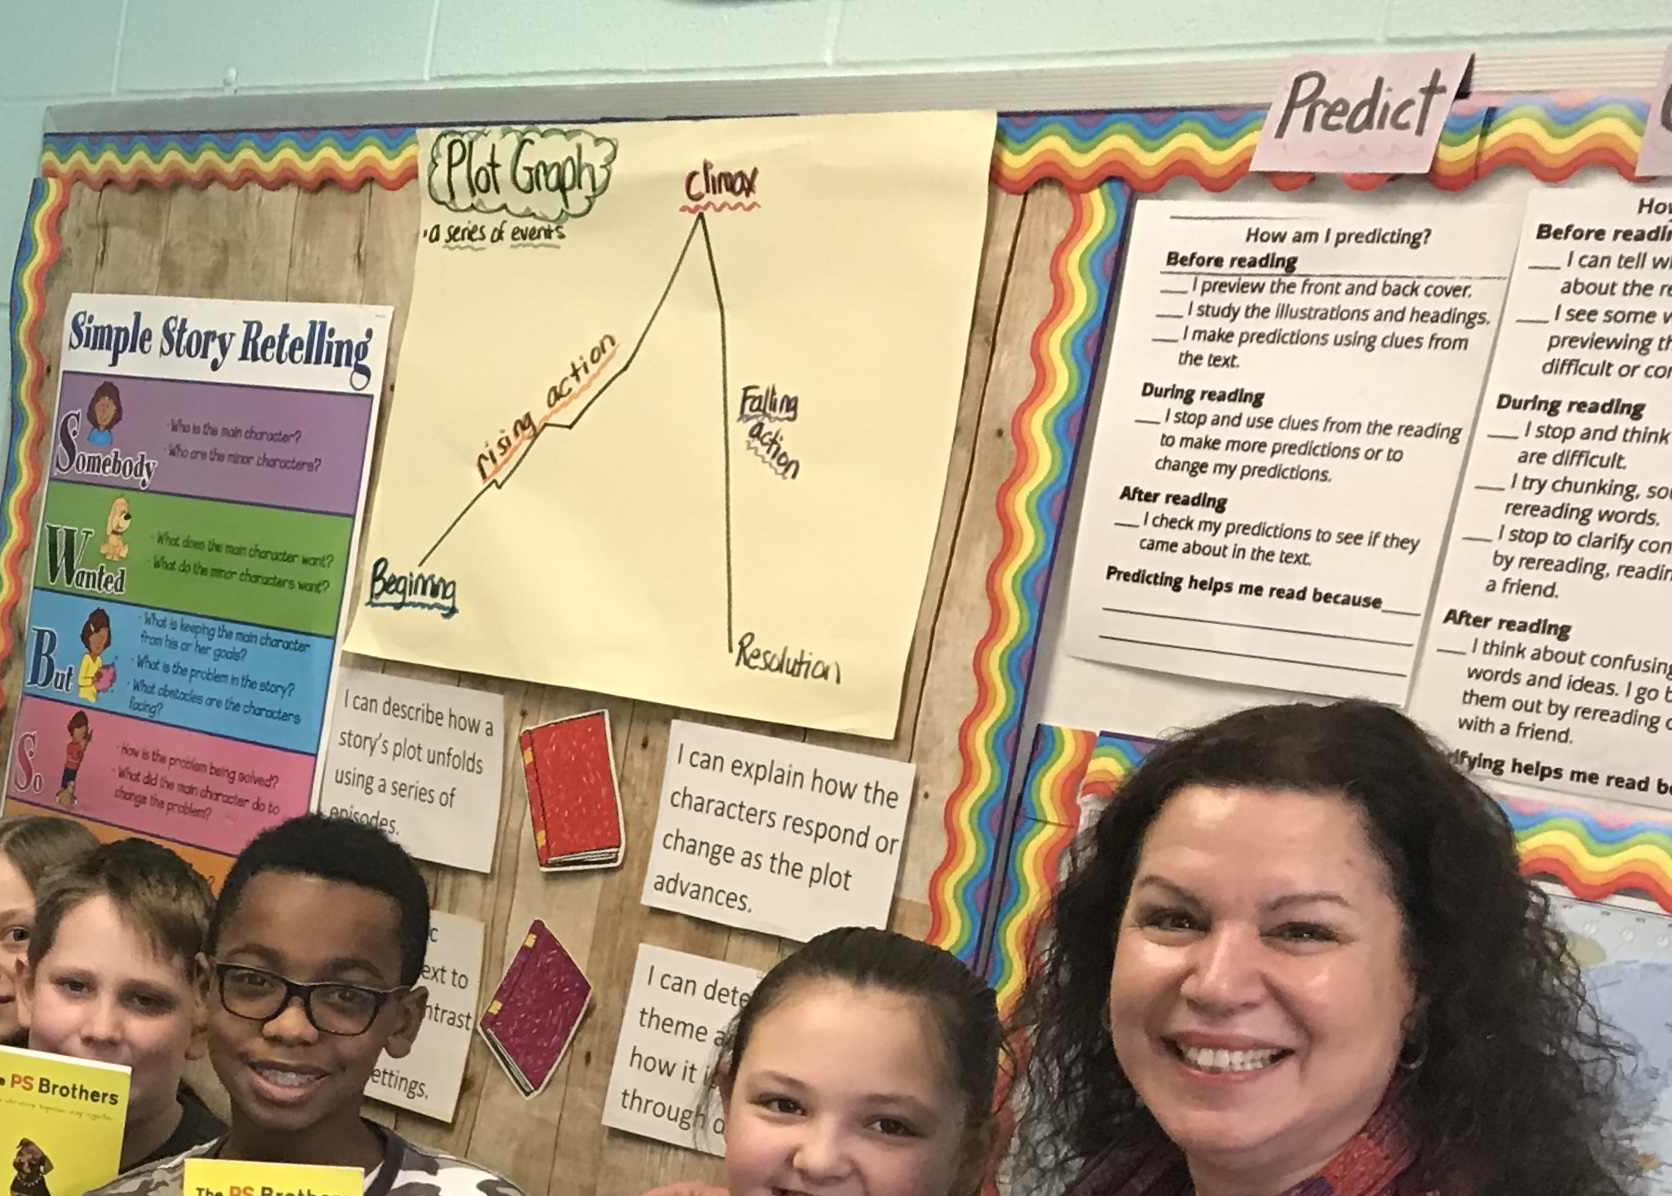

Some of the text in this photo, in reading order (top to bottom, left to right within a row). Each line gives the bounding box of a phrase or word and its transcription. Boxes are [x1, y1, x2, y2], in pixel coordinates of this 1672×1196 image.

[1274, 67, 1448, 140] Predict
[446, 138, 598, 209] Plot Graph
[429, 220, 567, 243] a series of events
[1245, 227, 1432, 248] How am I predicting?
[1535, 223, 1606, 241] Before
[1166, 251, 1298, 272] Before reading
[1192, 276, 1472, 298] I preview the front and back cover.
[1187, 300, 1490, 328] I study the illustrations and headings.
[68, 311, 373, 390] Simple Story Retelling
[475, 333, 617, 482] rising action
[739, 384, 799, 420] Falling
[1141, 382, 1265, 407] During reading
[1496, 393, 1646, 419] During reading
[54, 411, 157, 488] Somebody
[748, 423, 800, 480] action
[1517, 449, 1627, 470] are difficult.
[1118, 485, 1228, 512] After reading
[1504, 502, 1660, 526] rereading words.
[46, 525, 126, 594] Wanted
[1105, 565, 1383, 609] Predicting helps me read because
[1442, 608, 1572, 642] After reading
[27, 626, 74, 693] But
[735, 632, 841, 685] Resolution
[344, 688, 494, 737] I can describe how a
[1458, 715, 1573, 744] with a friend.
[14, 732, 43, 794] So
[391, 737, 423, 762] plot
[426, 746, 483, 775] unfolds
[1510, 757, 1650, 792] helps me read
[334, 768, 457, 808] using a series of
[677, 742, 899, 809] I can explain how the
[670, 786, 903, 855] characters respond or
[662, 828, 852, 891] change as the plot
[653, 874, 752, 913] advances.
[10, 1073, 34, 1091] PS
[38, 1077, 118, 1105] Brothers
